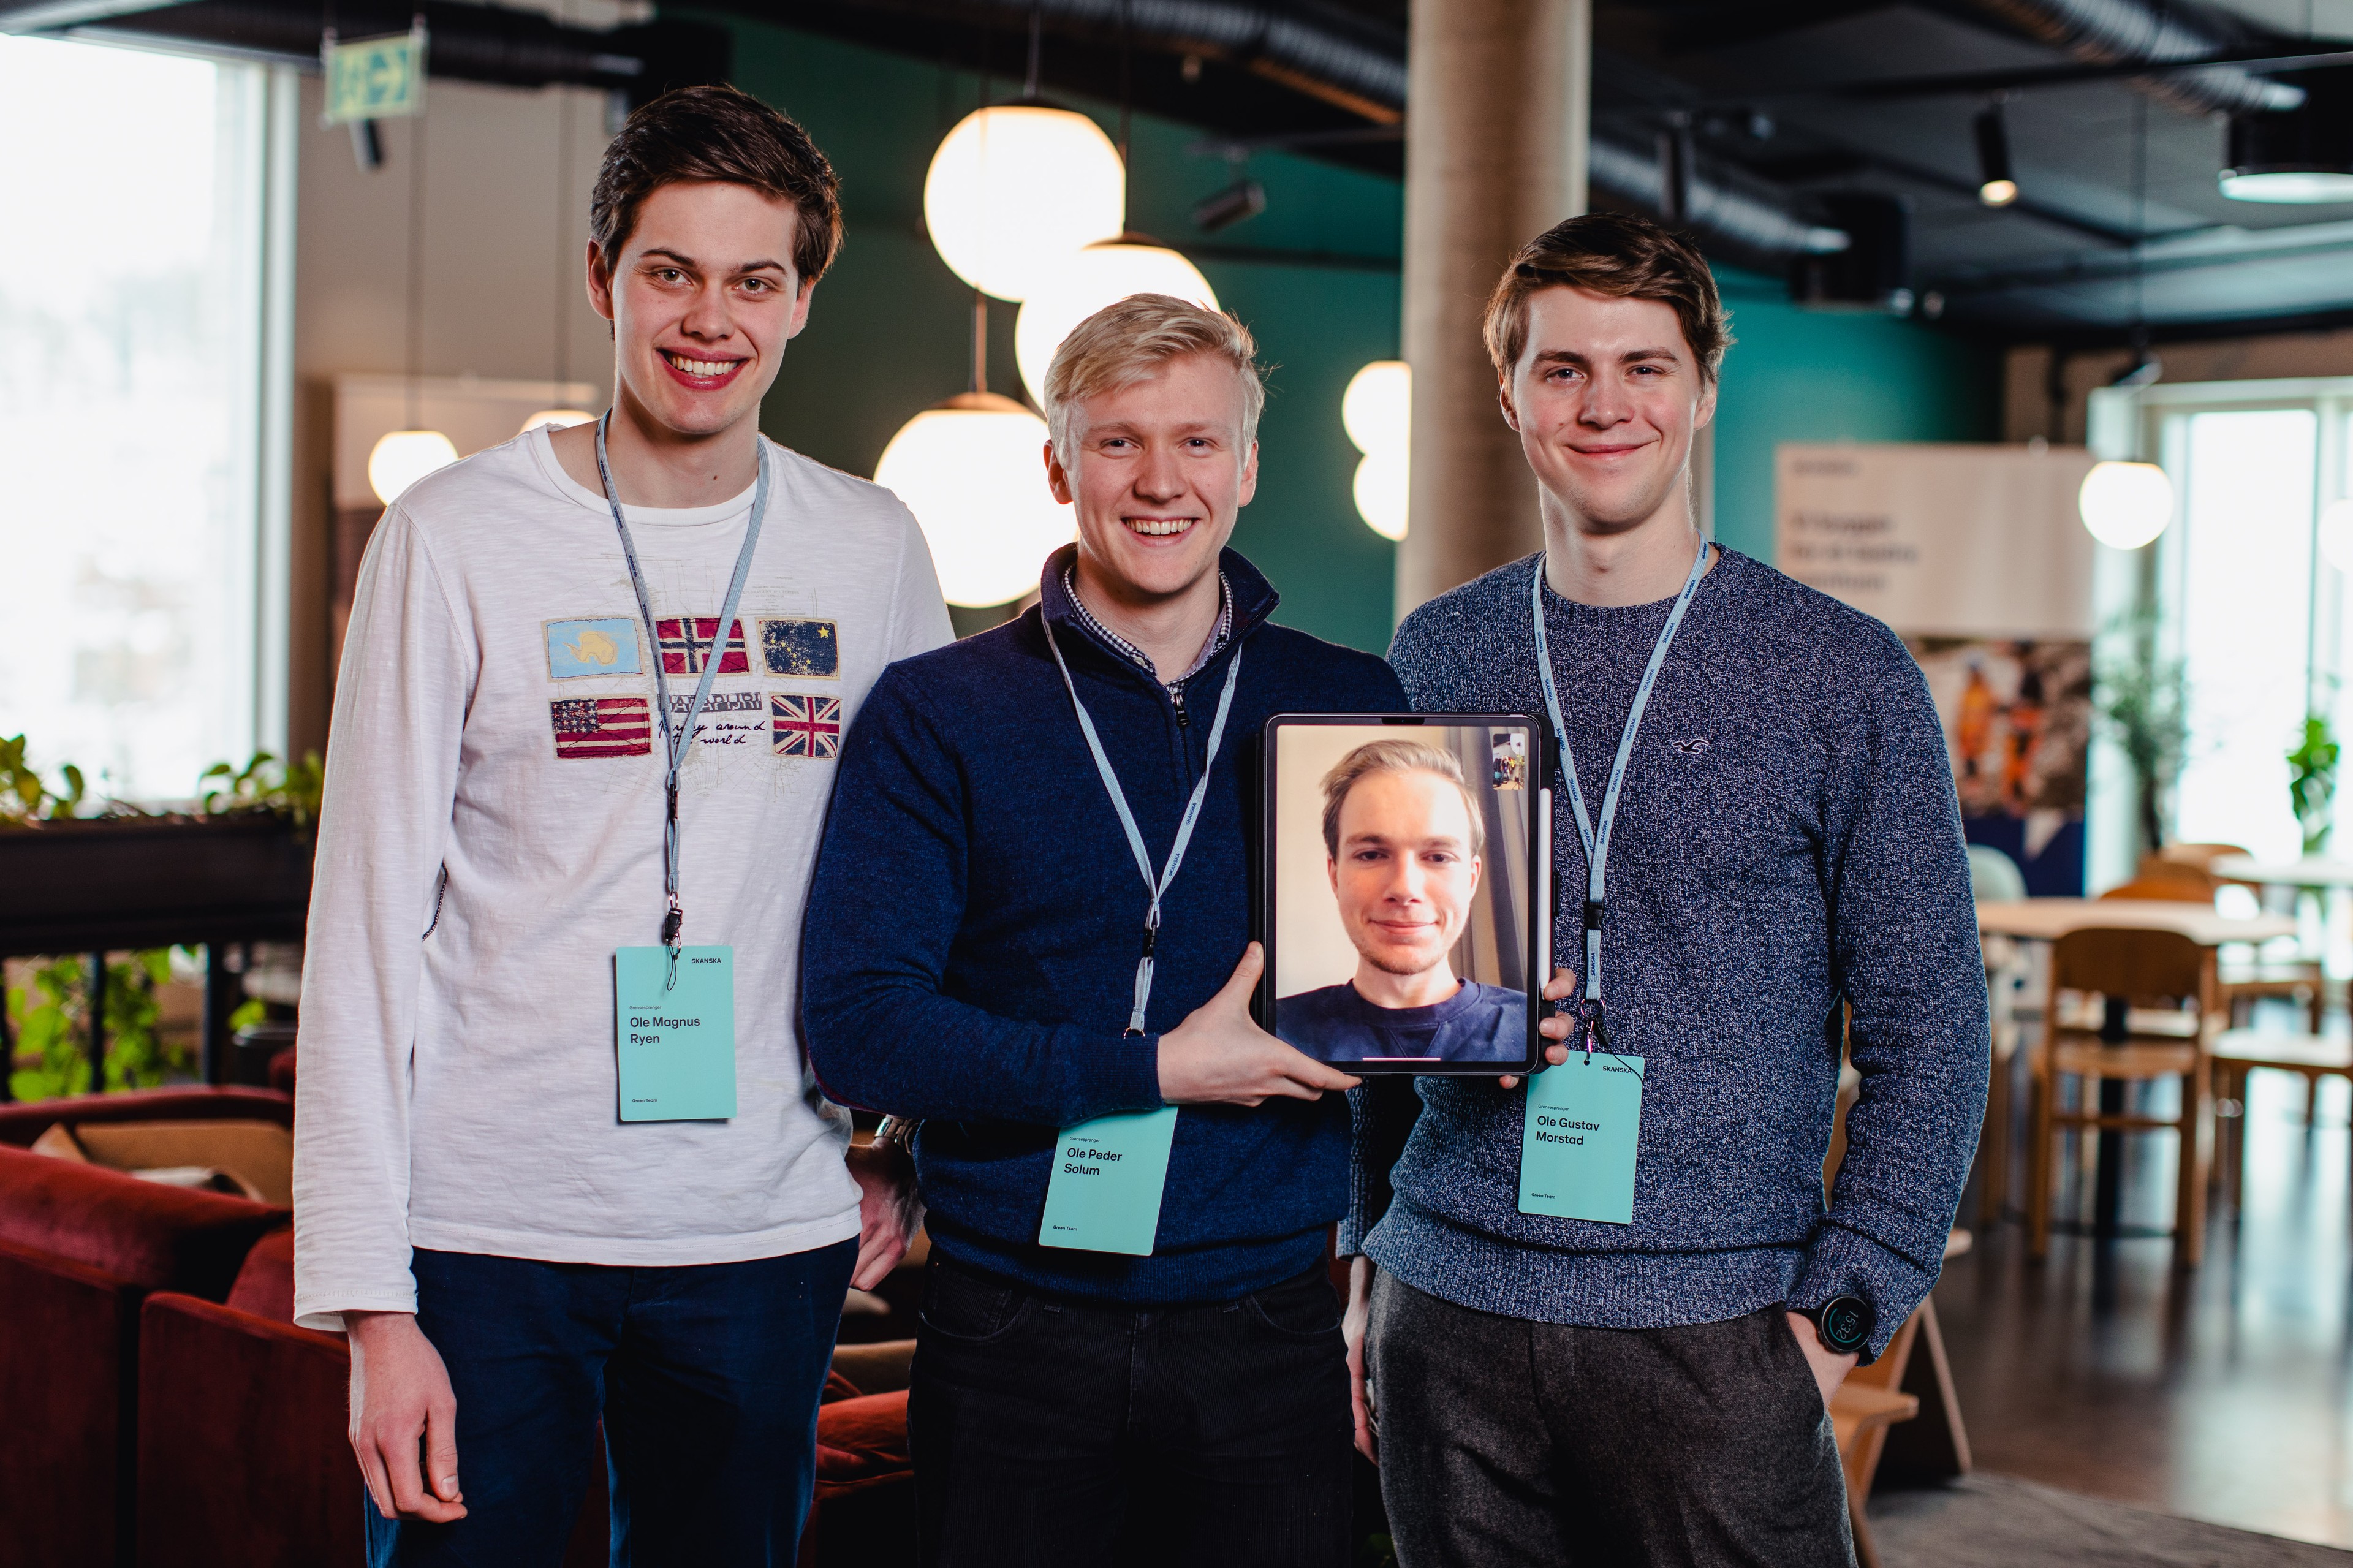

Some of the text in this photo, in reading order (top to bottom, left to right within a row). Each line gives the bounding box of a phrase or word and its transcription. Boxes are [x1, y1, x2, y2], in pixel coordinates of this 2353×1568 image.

[614, 506, 623, 529] SKANSKA
[629, 554, 637, 577] SKANSKA
[1684, 580, 1696, 600] SKANSKA
[1662, 623, 1675, 643] SKANSKA
[1544, 678, 1553, 702] SKANSKA
[1643, 668, 1654, 692] SKANSKA
[716, 721, 765, 730] around
[1626, 718, 1636, 741] SKANSKA
[700, 734, 746, 744] world
[1556, 727, 1566, 751] SKANSKA
[1569, 778, 1578, 802] SKANSKA
[1610, 768, 1621, 793] SKANSKA
[1186, 803, 1197, 825] SKANSKA
[1599, 820, 1608, 844] SKANSKA
[1168, 853, 1180, 877] SKANSKA
[630, 1017, 700, 1029] Ole Magnus
[631, 1034, 660, 1046] Ryen
[1537, 1115, 1600, 1131] Ole Gustav
[1536, 1131, 1583, 1145] Morstad
[1067, 1148, 1122, 1161] Ole Peder
[1064, 1163, 1100, 1175] Solum
[1836, 1311, 1859, 1339] 15:32
